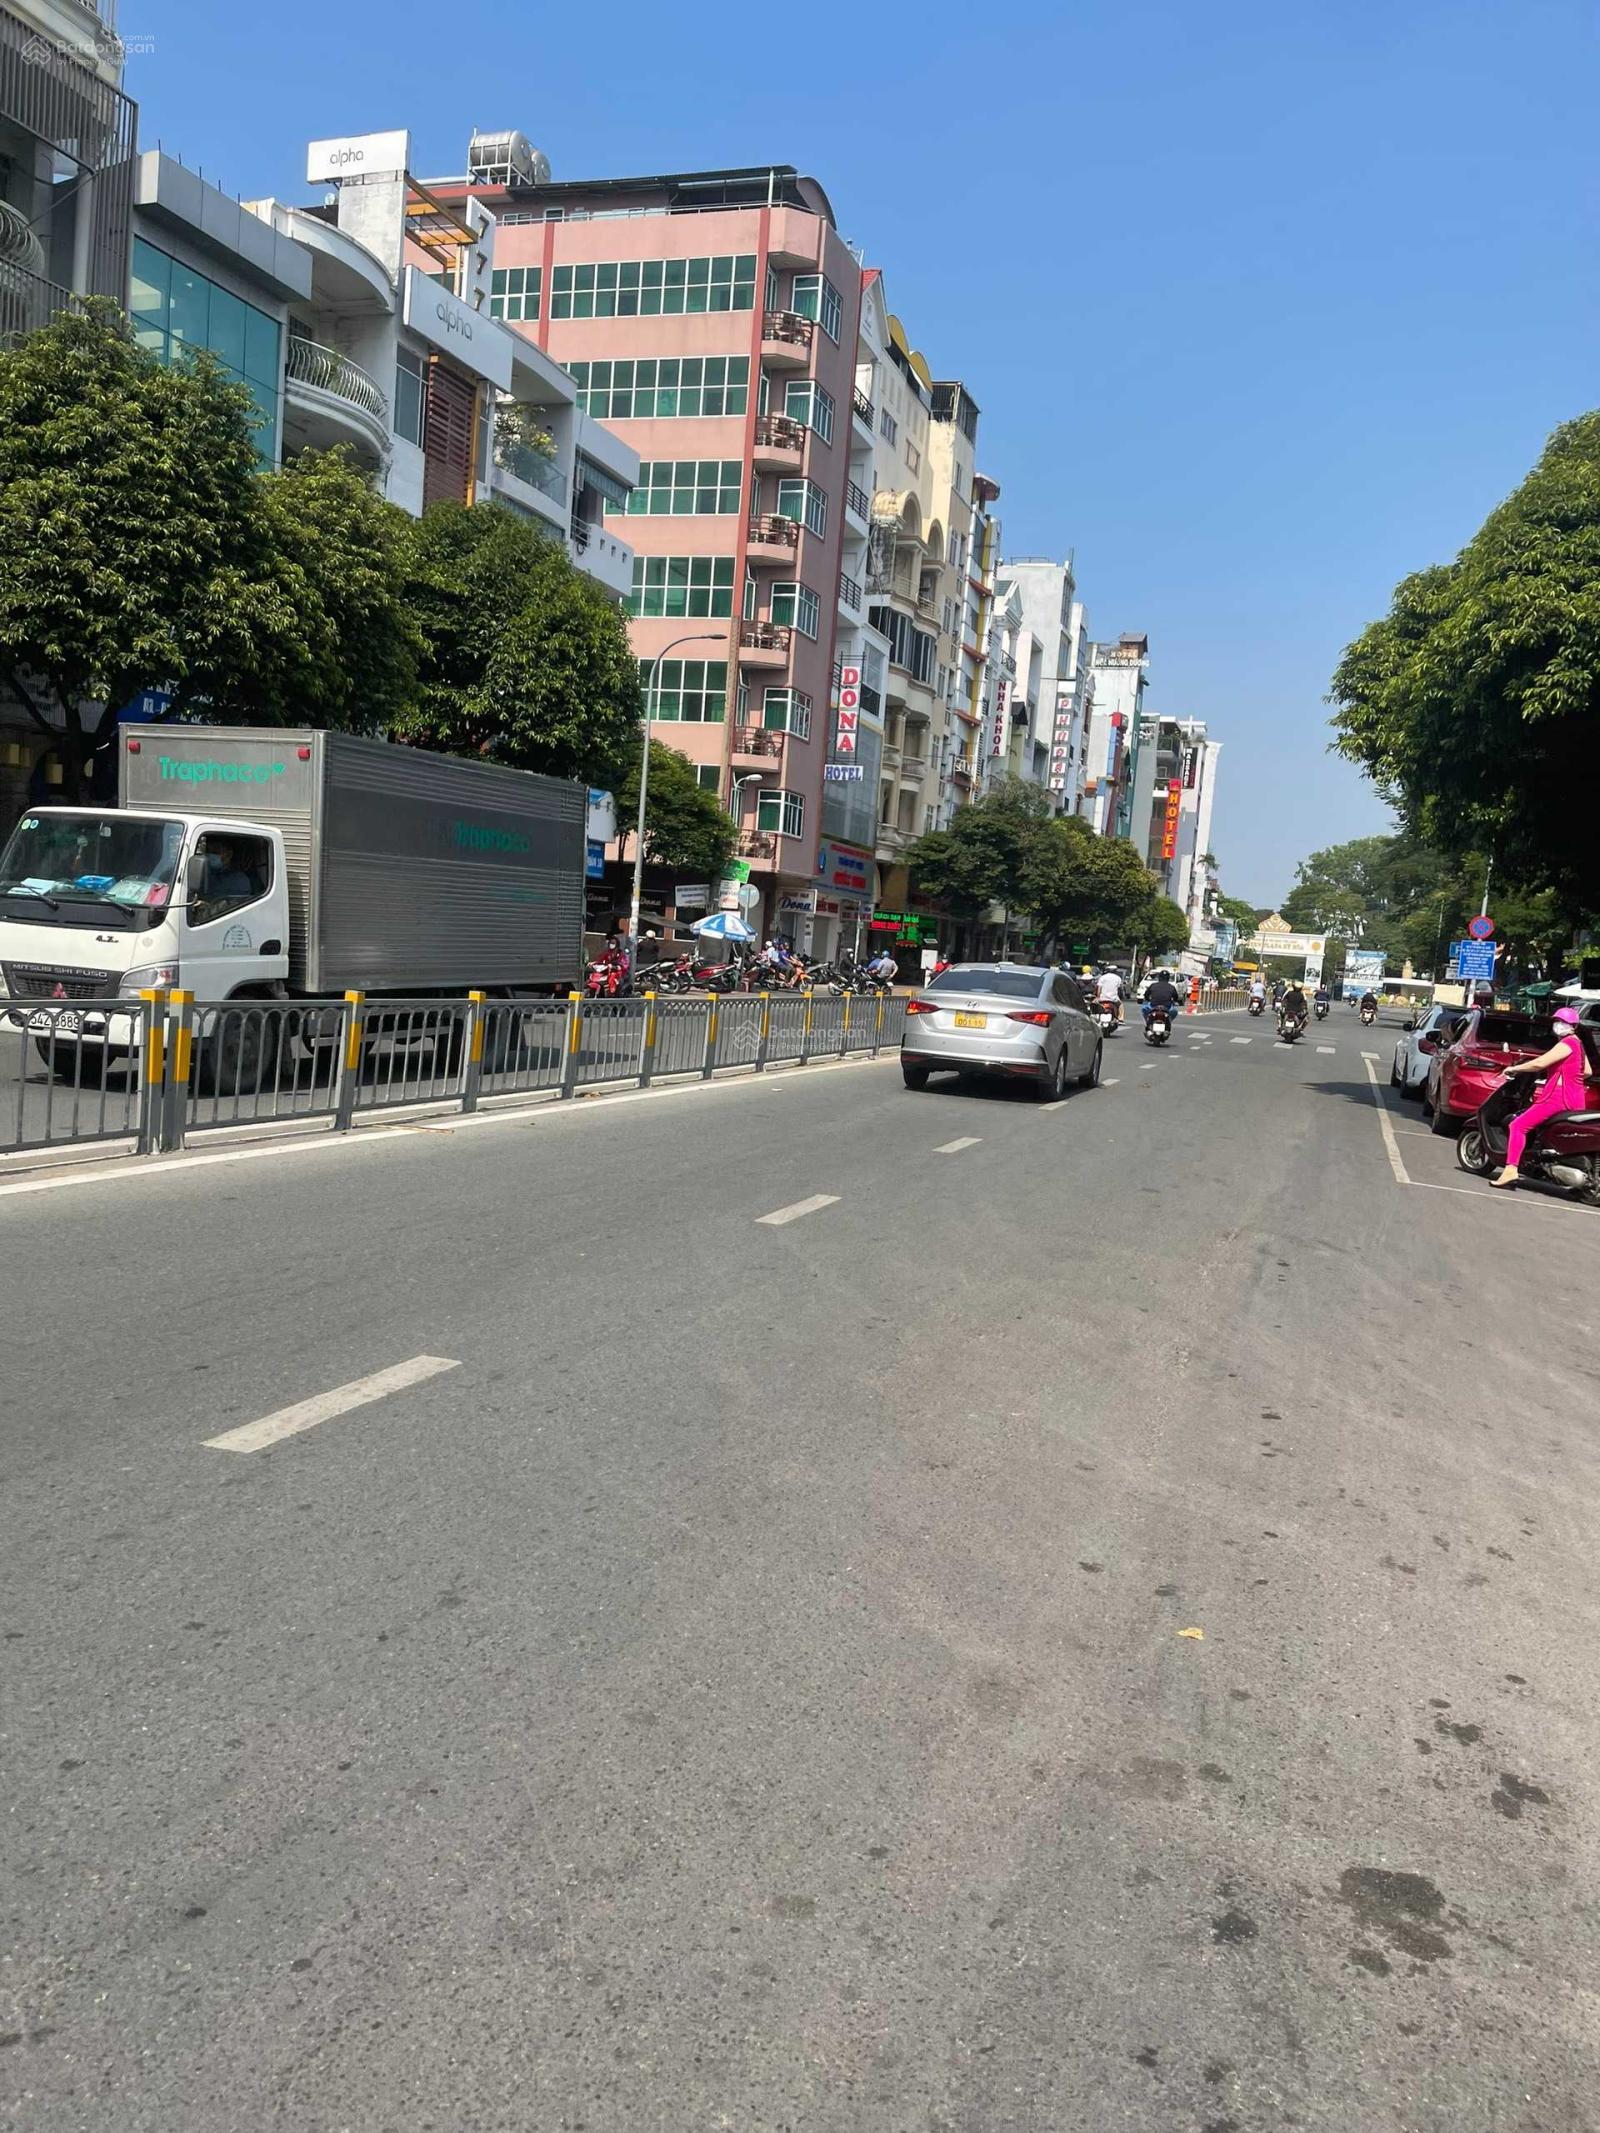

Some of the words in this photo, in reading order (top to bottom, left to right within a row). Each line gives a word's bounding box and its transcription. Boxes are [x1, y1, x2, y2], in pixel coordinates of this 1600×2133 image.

[330, 148, 364, 167] alpha
[436, 301, 473, 341] alpha
[838, 668, 858, 751] DONA
[996, 682, 1007, 712] NHA
[993, 715, 1003, 755] KHOA
[159, 755, 271, 790] Traphaco
[824, 765, 862, 781] HOTEL
[1164, 793, 1179, 858] HOTEL
[780, 896, 812, 912] Dona
[12, 963, 73, 975] MITSUBSHI
